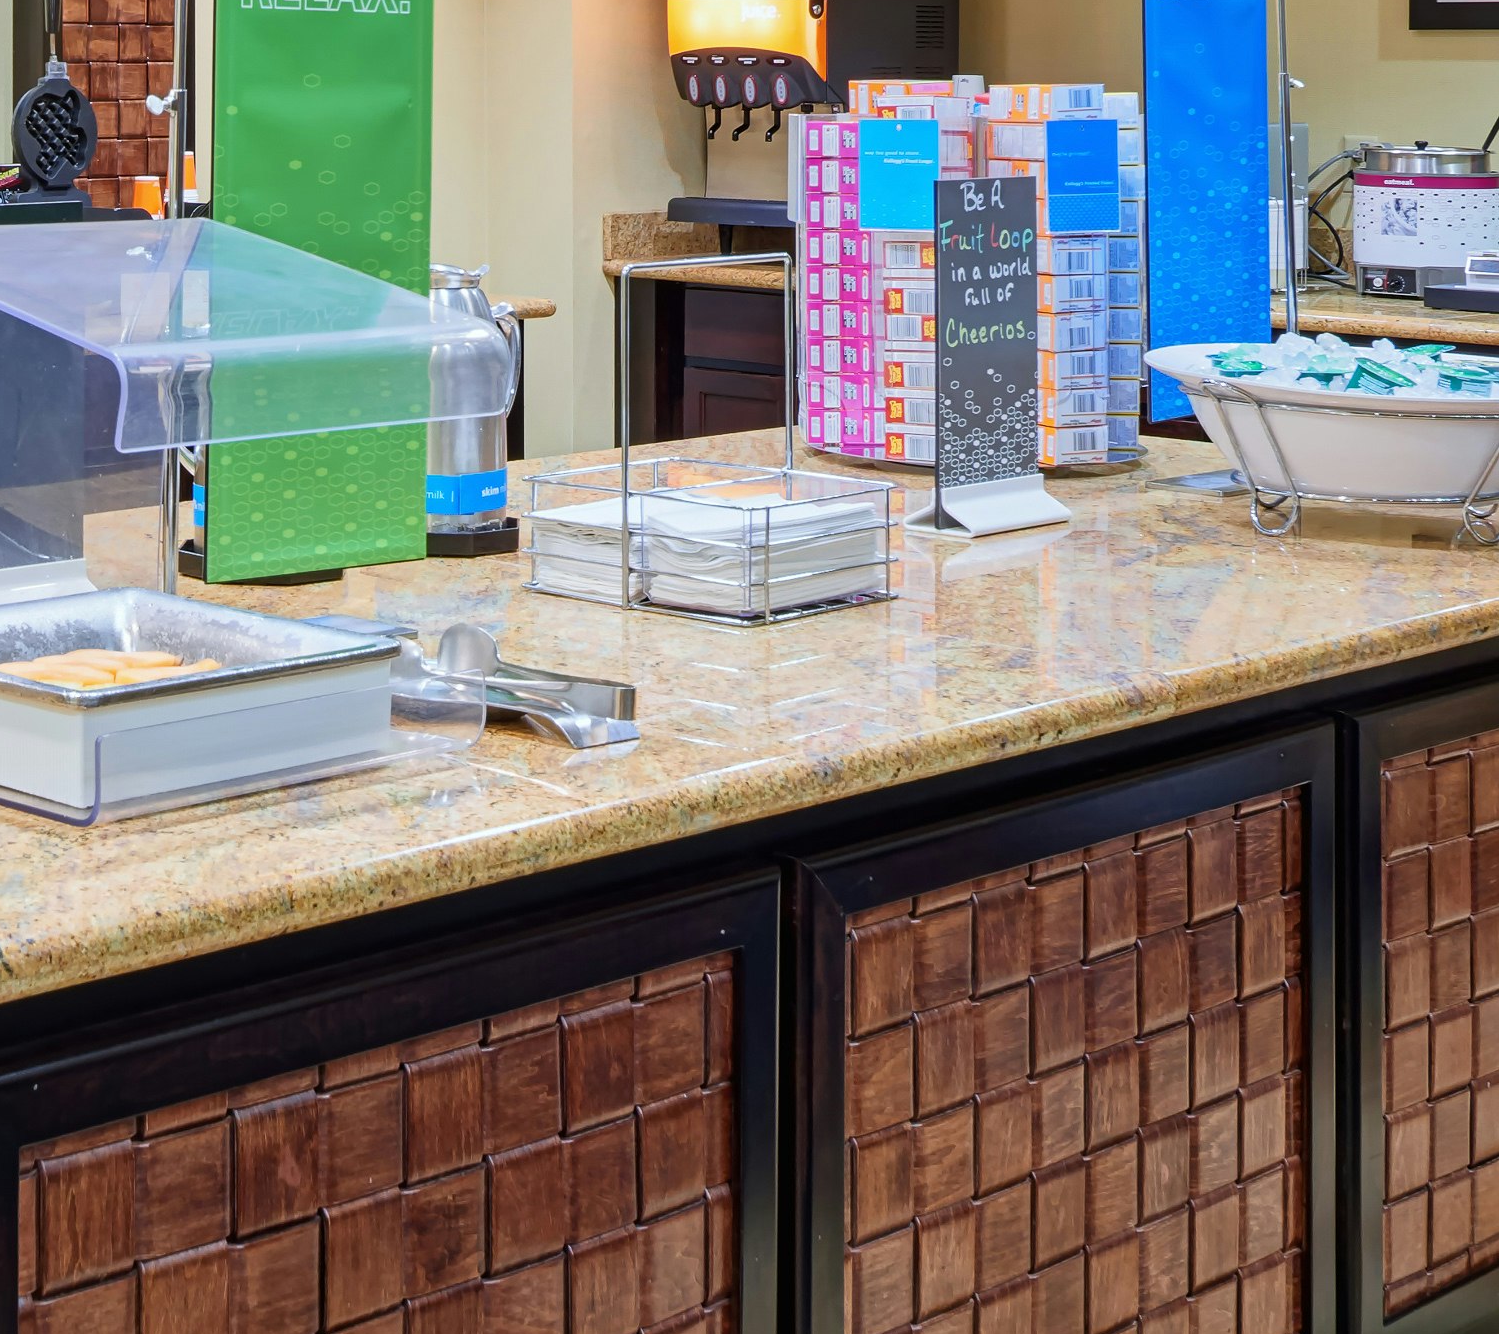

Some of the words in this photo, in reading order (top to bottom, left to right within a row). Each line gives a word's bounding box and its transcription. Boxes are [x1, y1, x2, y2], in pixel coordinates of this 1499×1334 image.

[959, 181, 987, 213] Be
[991, 179, 1005, 210] A
[939, 219, 985, 254] Fruit
[951, 262, 967, 283] in
[972, 266, 982, 281] a
[989, 256, 1032, 280] world
[996, 282, 1015, 303] of
[945, 317, 1026, 348] Cheerios
[426, 490, 445, 499] milk
[481, 485, 499, 498] skim
